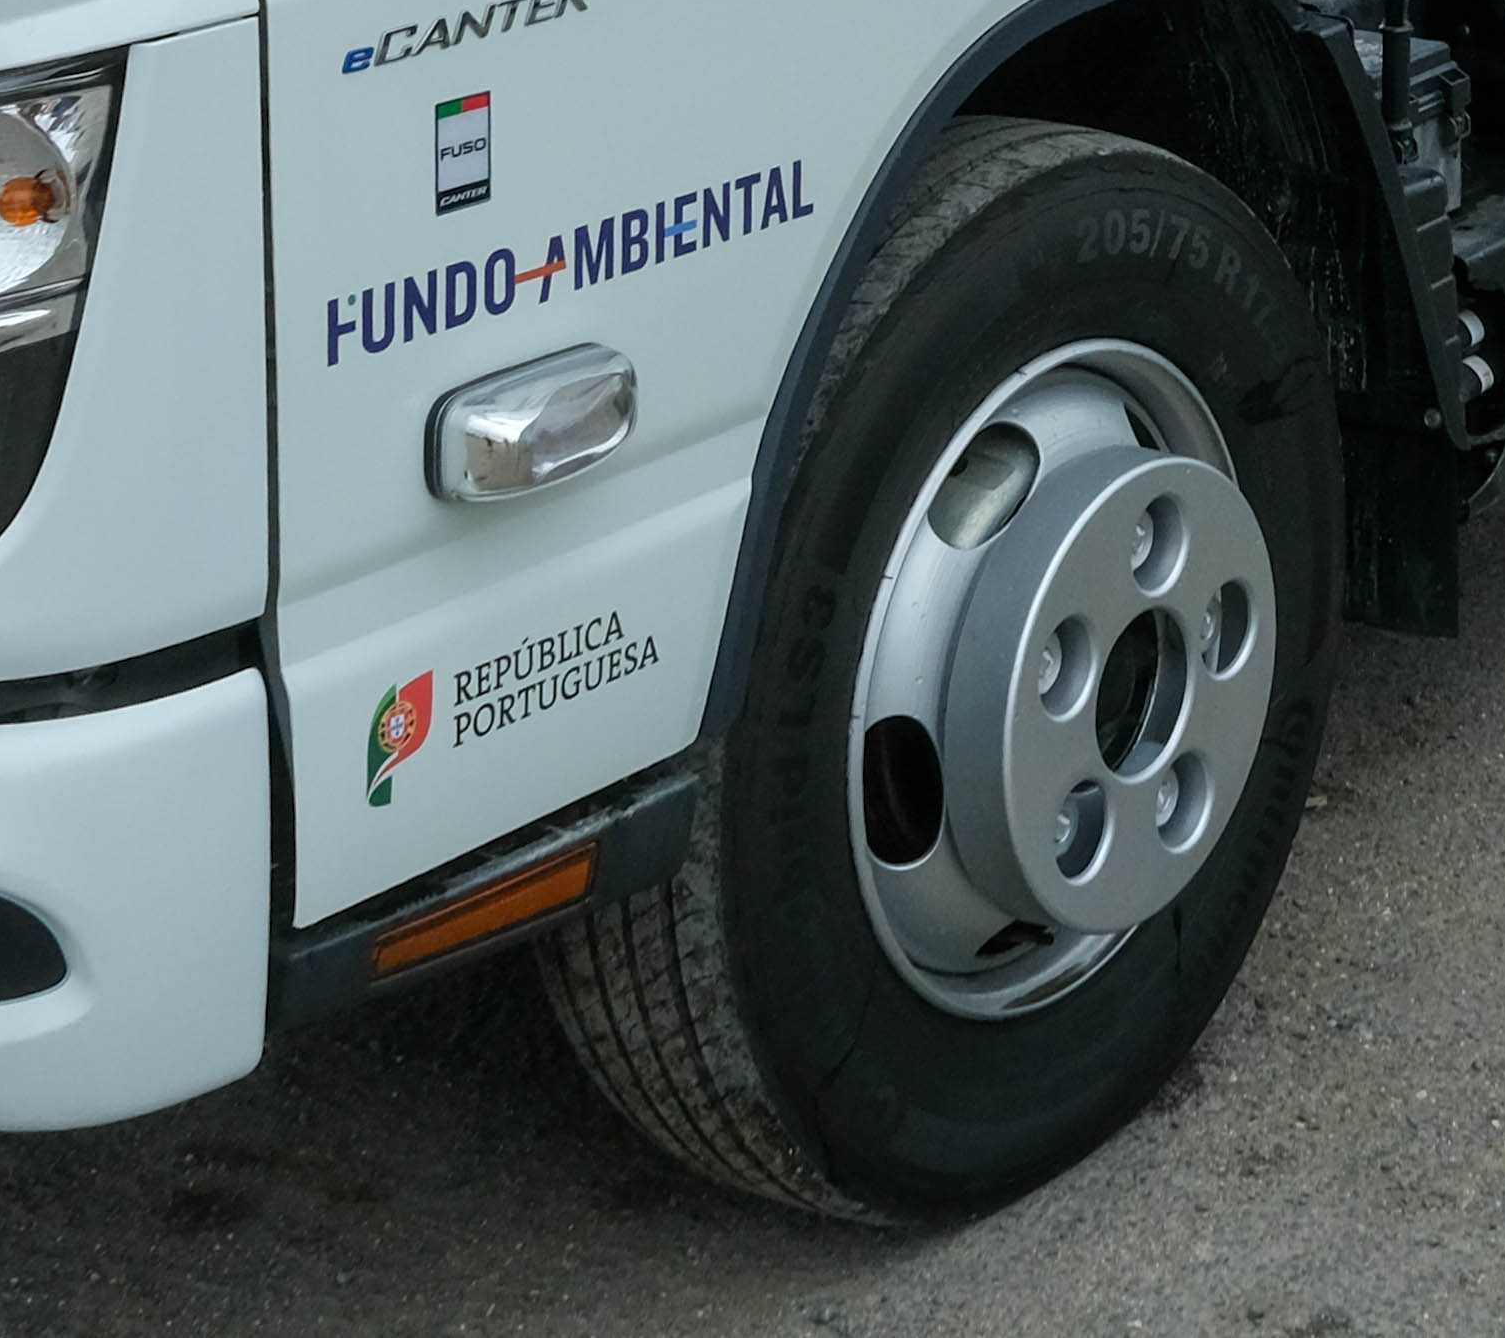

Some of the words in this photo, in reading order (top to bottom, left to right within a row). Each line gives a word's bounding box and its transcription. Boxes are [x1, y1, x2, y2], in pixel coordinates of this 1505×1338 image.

[440, 137, 487, 161] FUSO
[440, 186, 488, 206] CANTER
[327, 248, 516, 366] FUNDO
[452, 636, 659, 747] PORTUGUESA
[453, 610, 624, 707] REPÚBLICA
